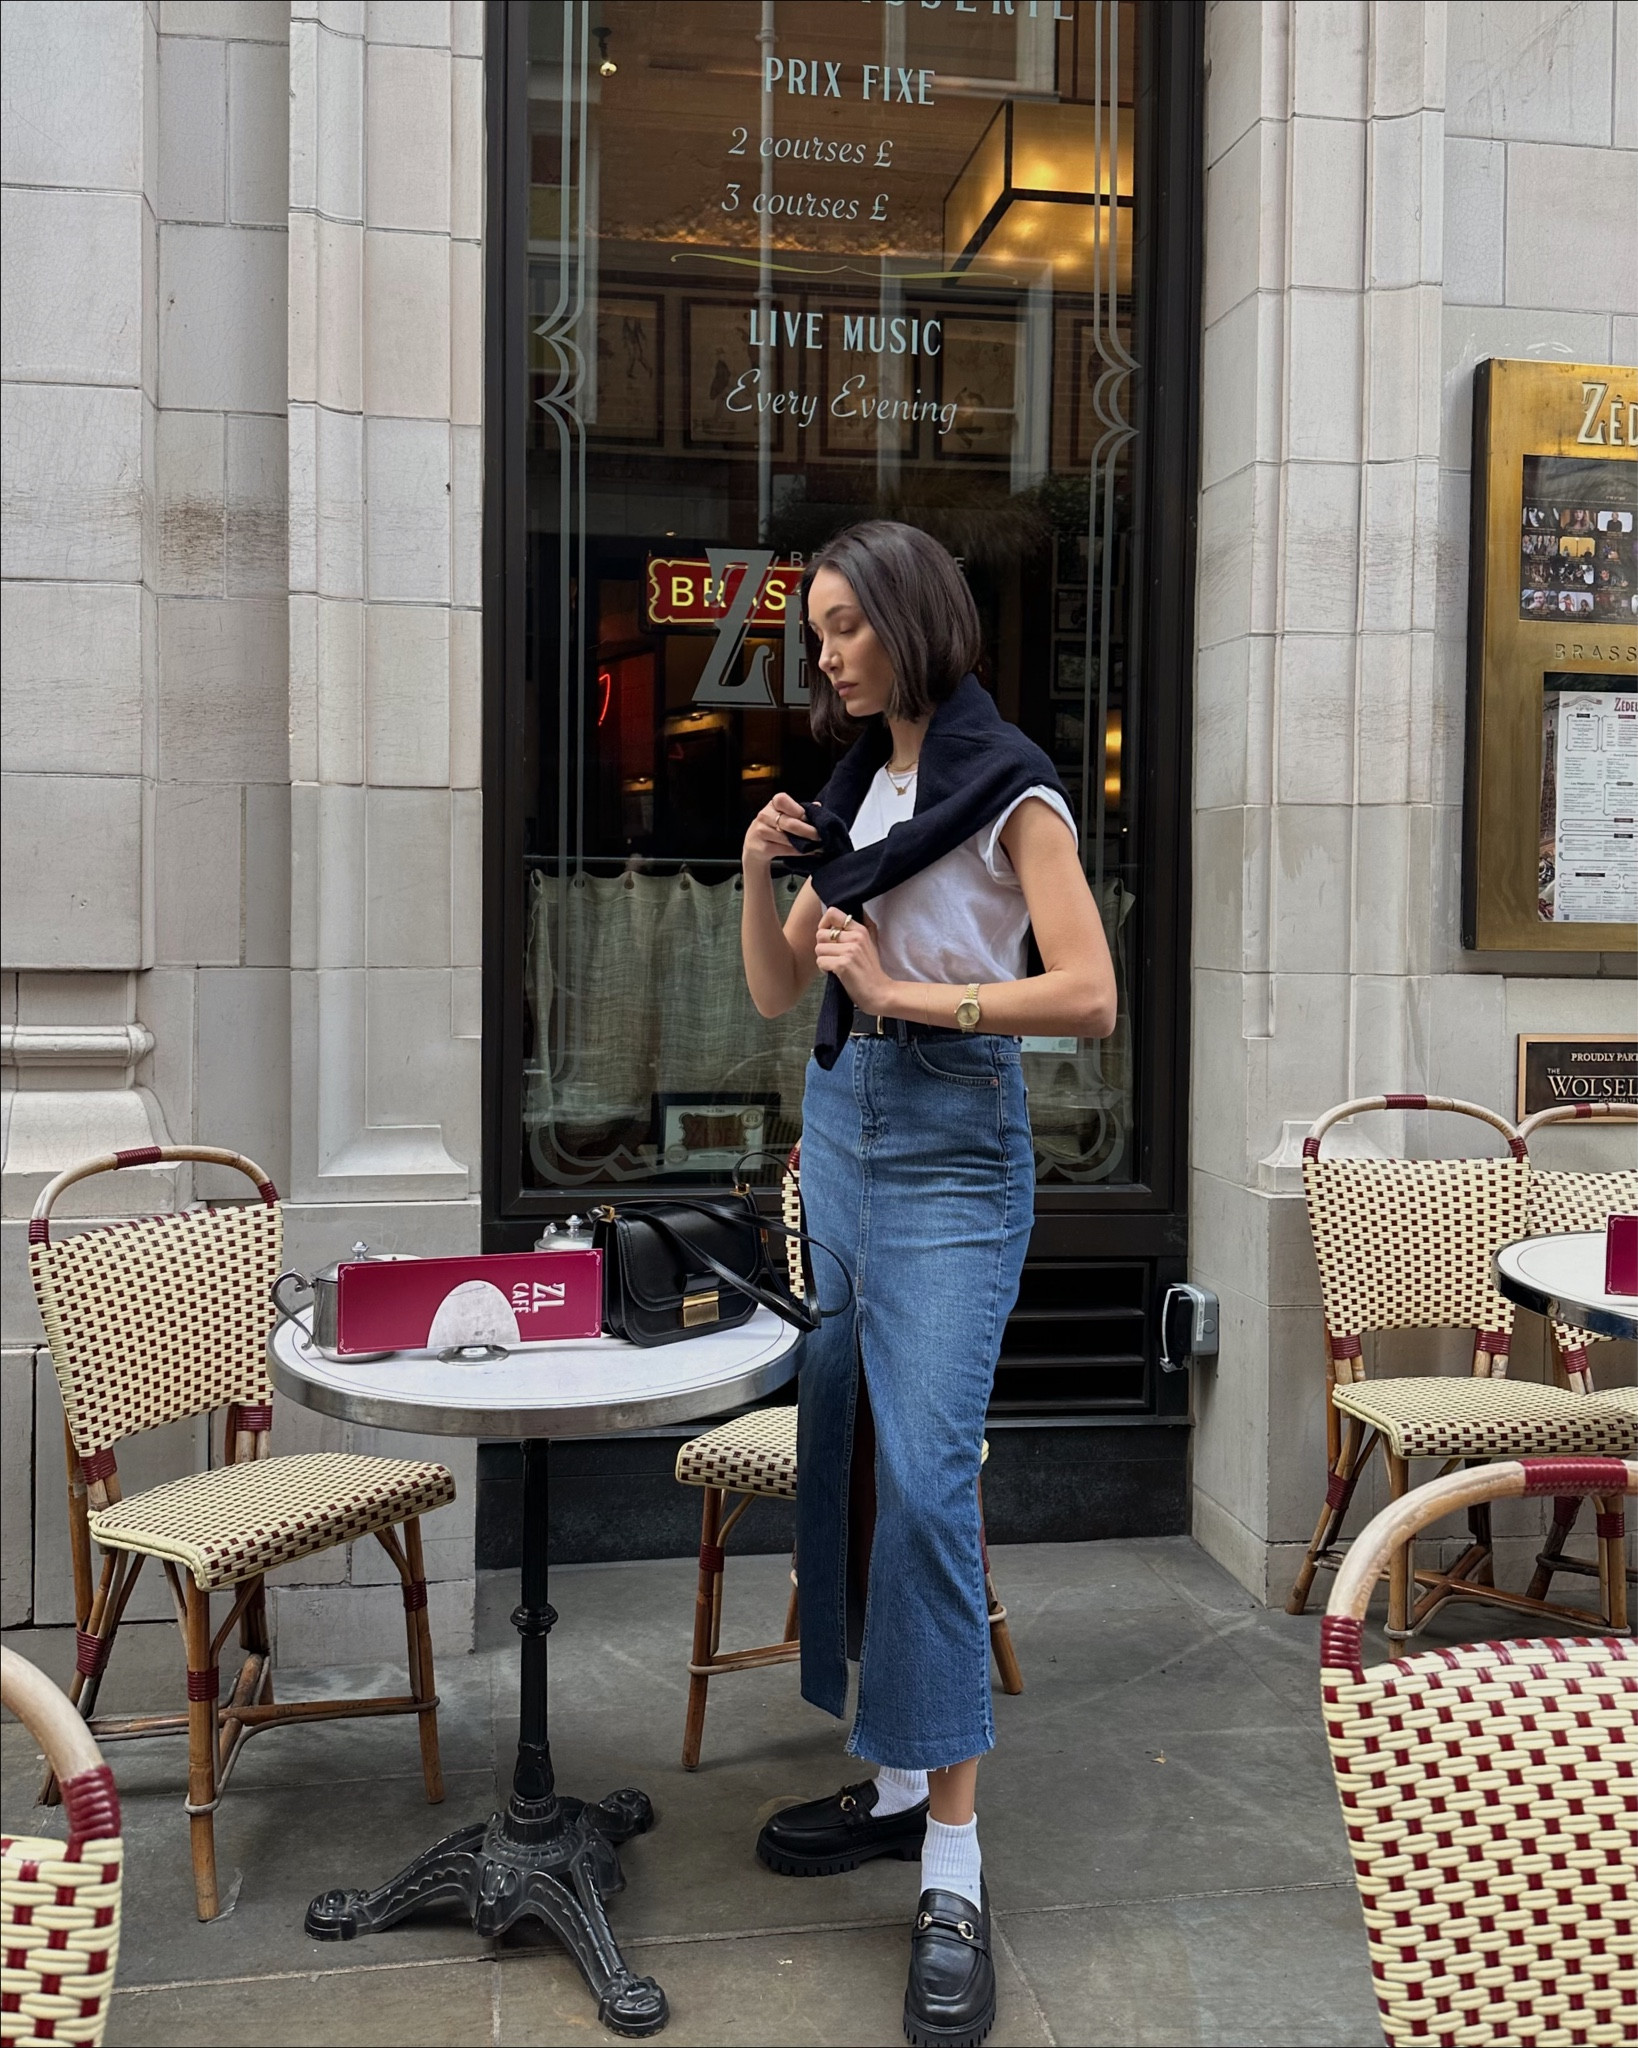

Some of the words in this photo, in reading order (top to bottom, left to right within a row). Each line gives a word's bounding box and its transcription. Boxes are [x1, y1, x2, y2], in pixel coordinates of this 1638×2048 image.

[765, 57, 841, 98] PRIX
[862, 64, 935, 105] FIXE
[728, 126, 748, 155] 2
[759, 136, 867, 164] courses
[873, 140, 894, 167] £
[721, 183, 741, 211] 3
[752, 193, 860, 220] courses
[869, 193, 889, 221] £
[749, 309, 824, 349] LIVE
[843, 315, 942, 356] MUSIC
[725, 368, 818, 427] Every
[830, 374, 958, 435] Evening
[1555, 643, 1638, 662] BRASS
[1547, 1067, 1561, 1075] THE
[1571, 1052, 1616, 1062] PROUDLY
[511, 1282, 532, 1314] CAFÉ
[532, 1281, 566, 1314] ZL
